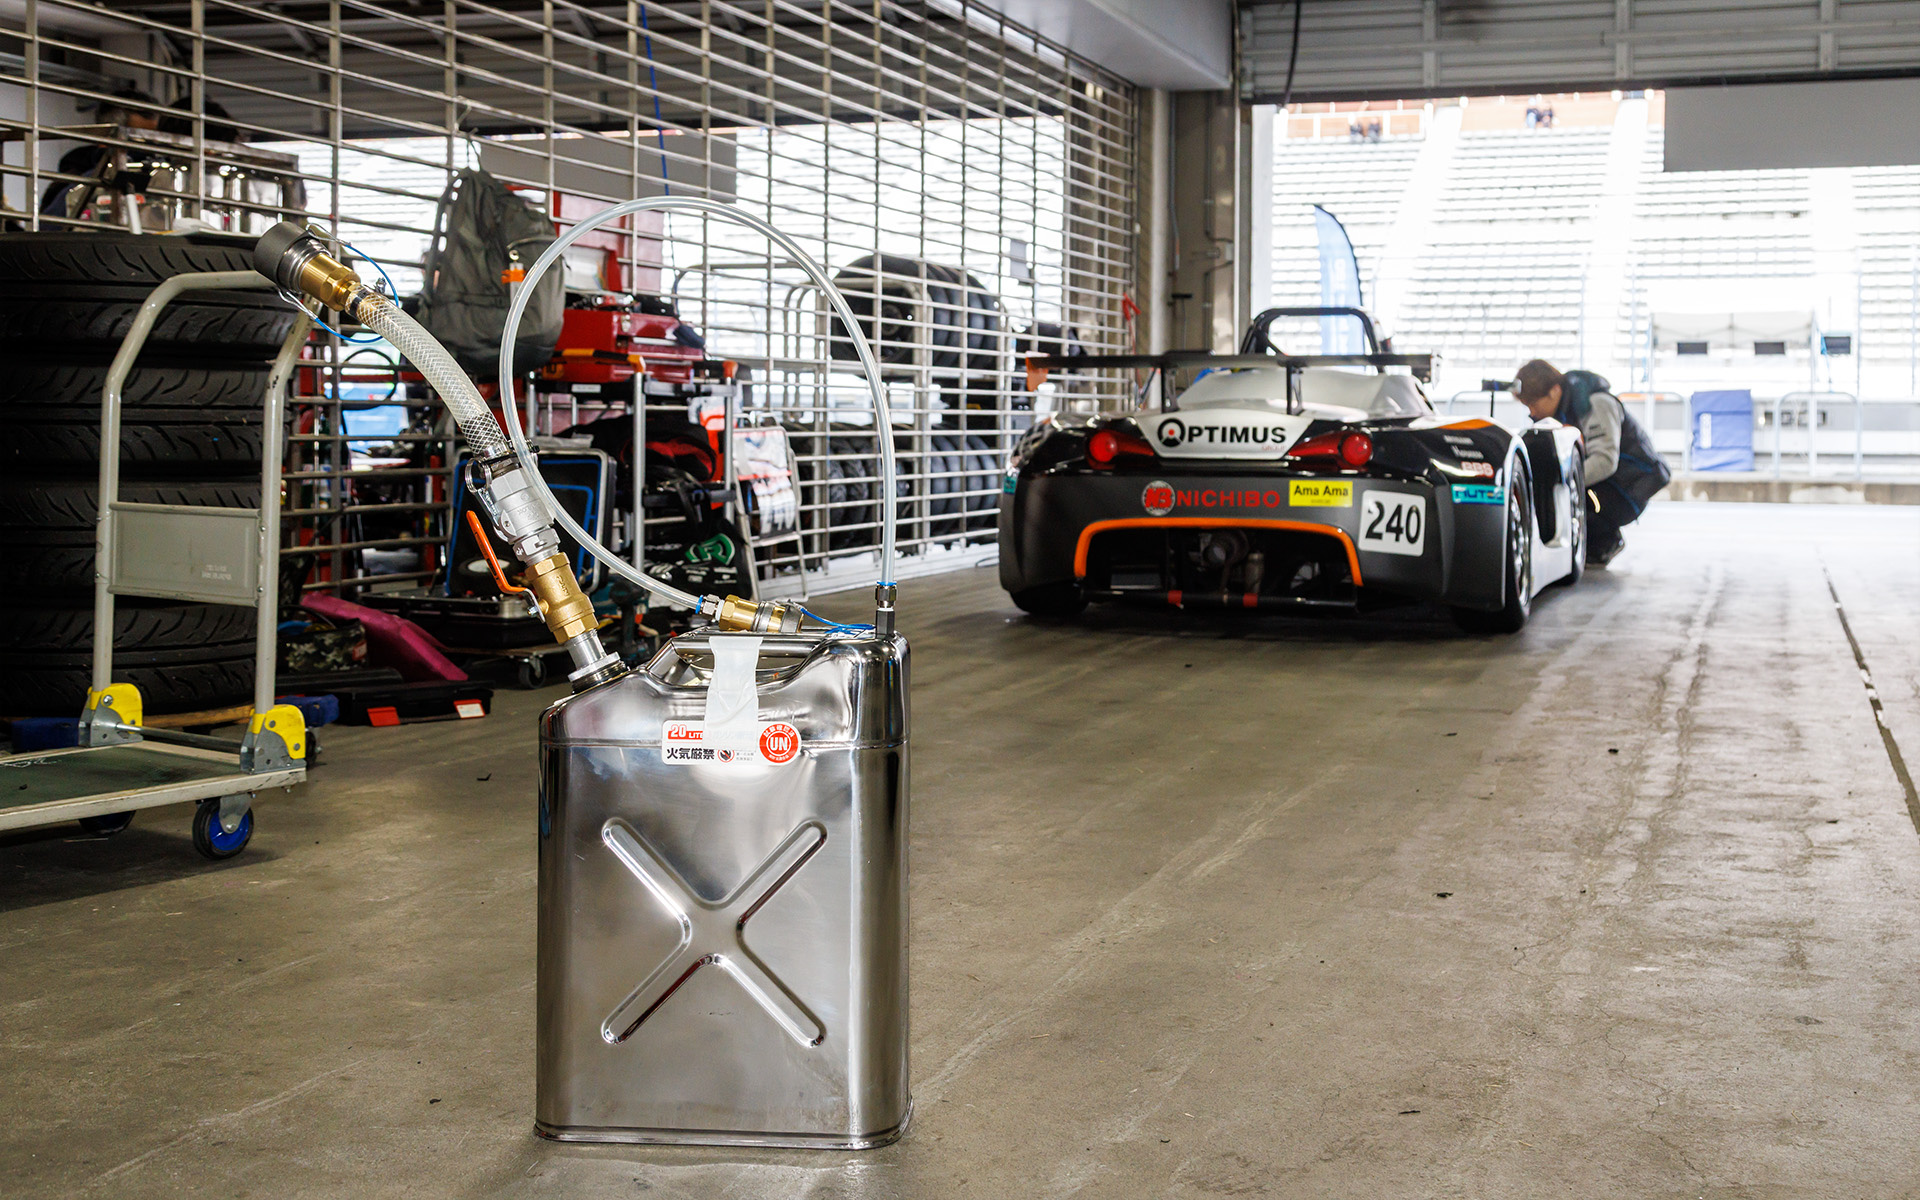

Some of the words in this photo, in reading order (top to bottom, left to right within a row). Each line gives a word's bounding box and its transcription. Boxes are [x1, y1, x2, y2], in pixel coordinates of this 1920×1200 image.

[1157, 417, 1286, 448] OPTIMUS
[1176, 489, 1280, 508] NICHIBO
[1294, 485, 1320, 497] Ama
[1323, 485, 1349, 497] Ama
[1365, 501, 1421, 545] 240
[670, 724, 687, 738] 20
[770, 736, 788, 751] UN
[666, 747, 715, 760] 火気厳禁
